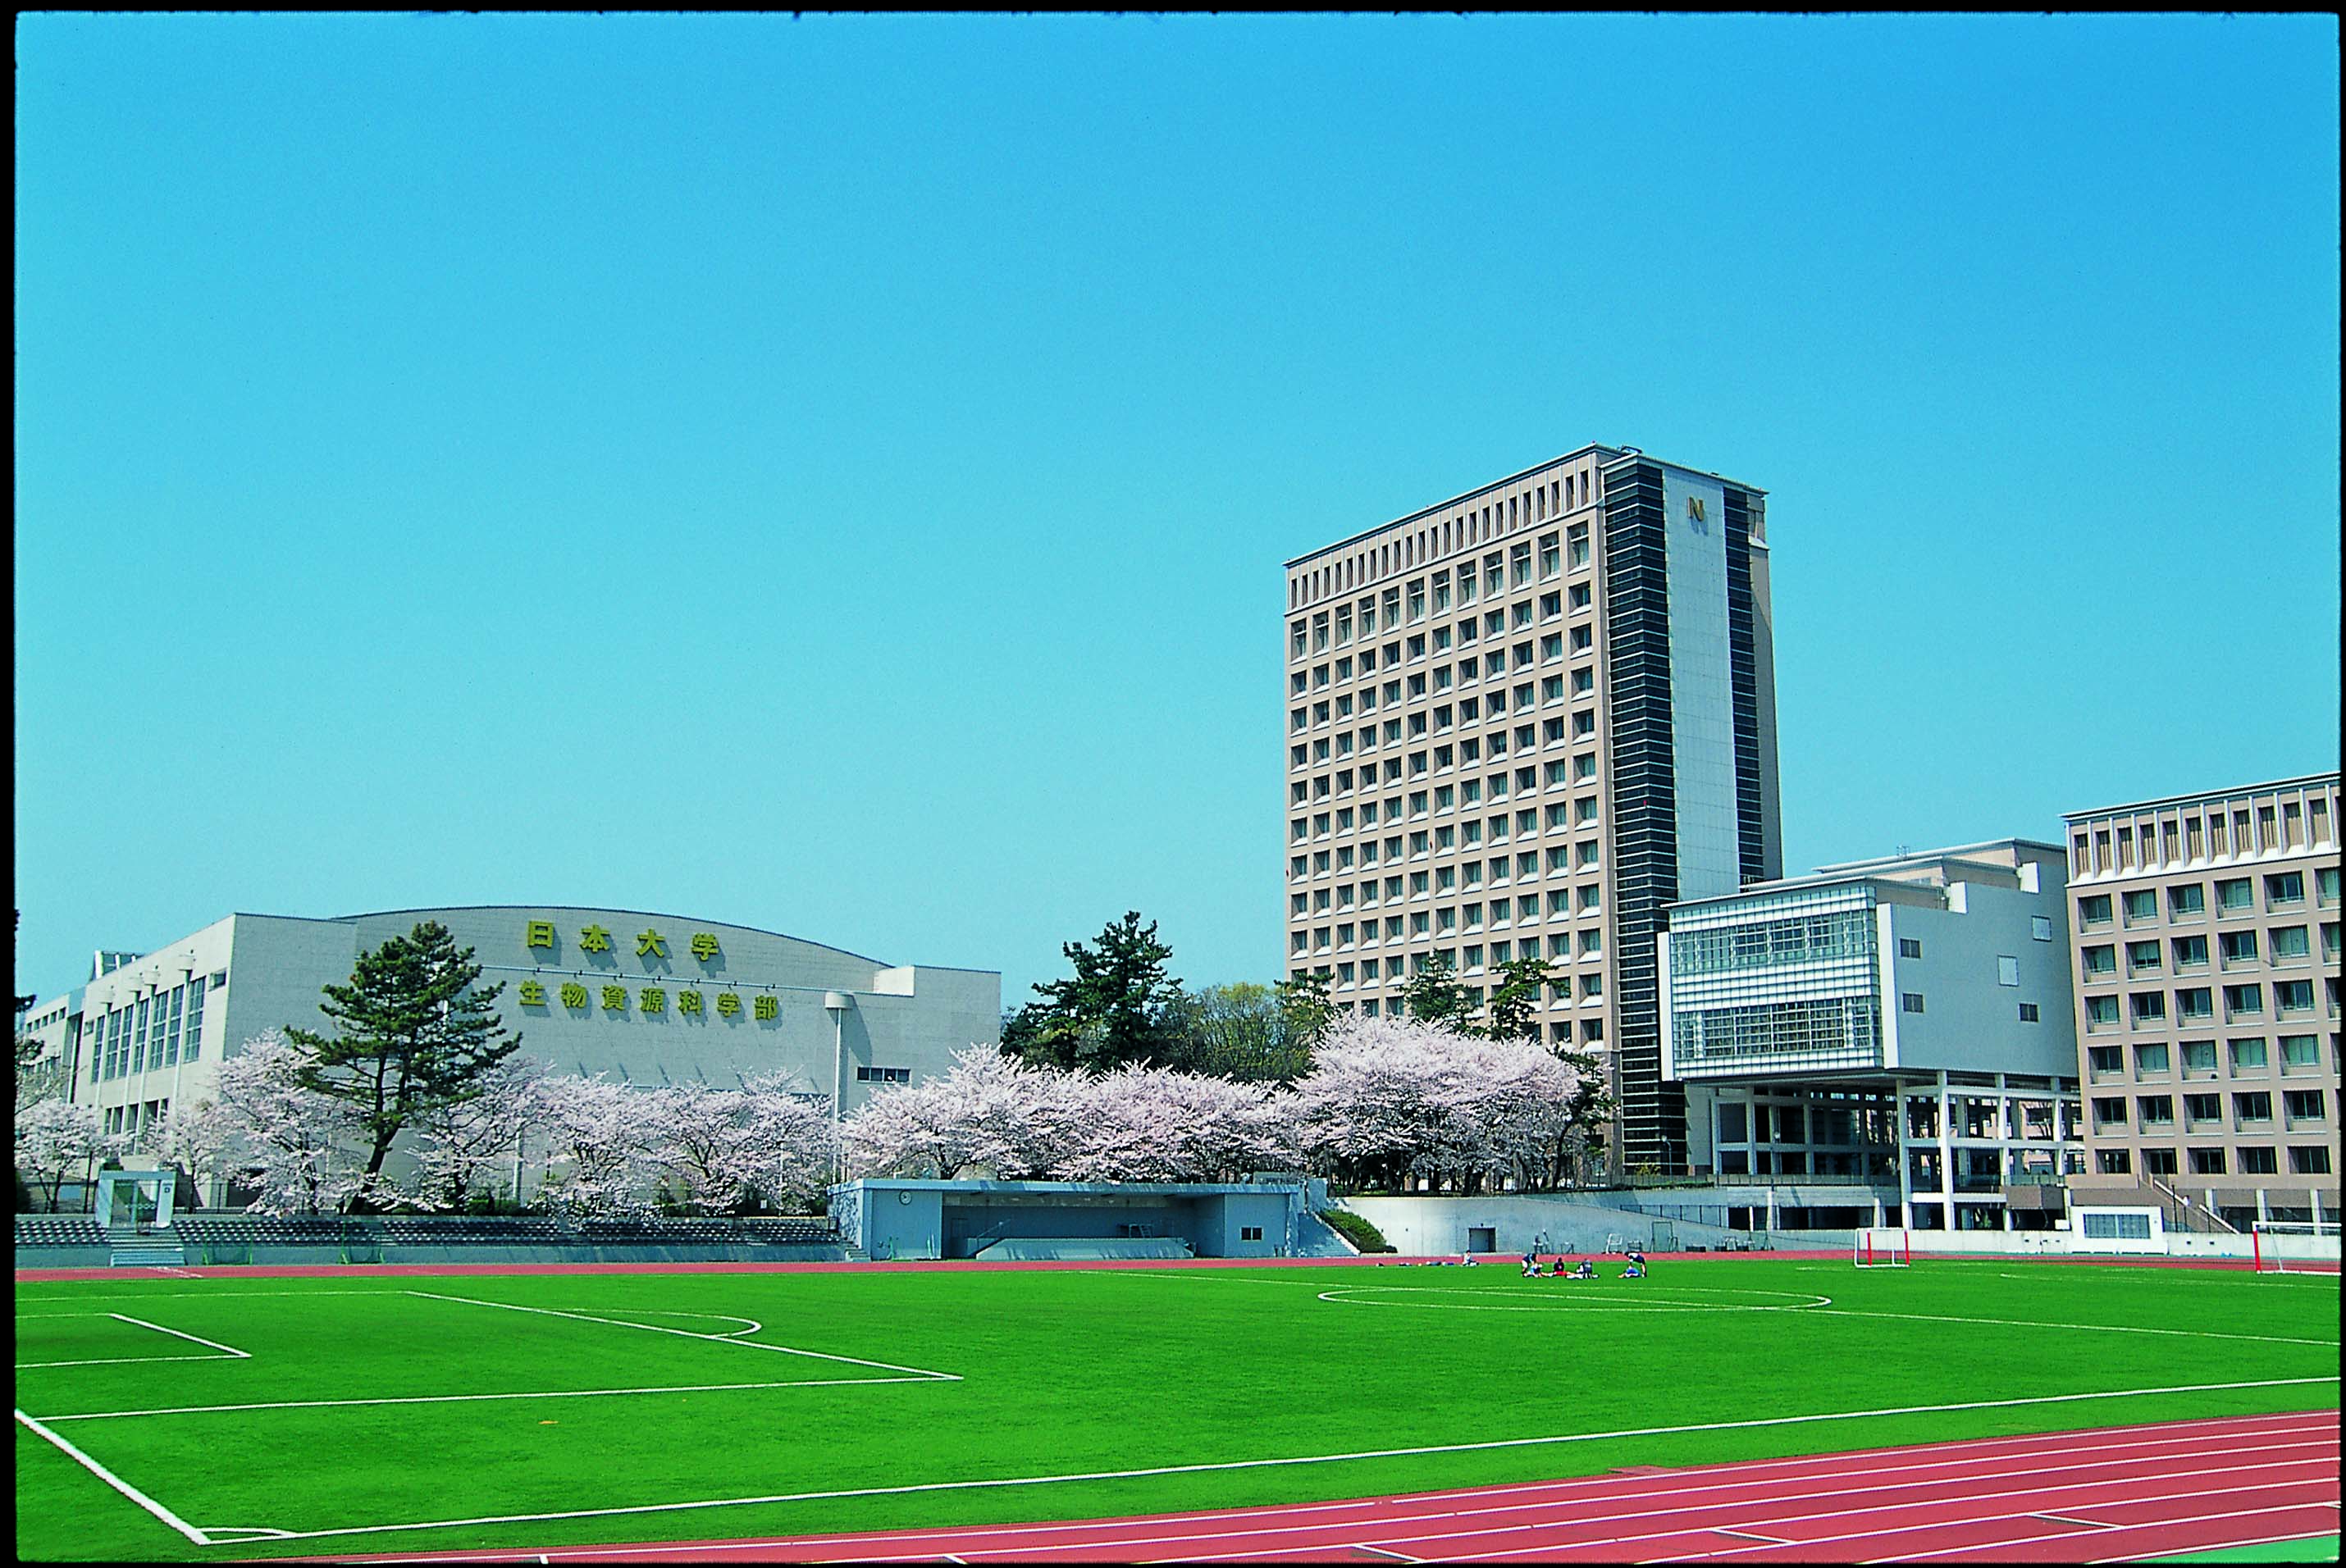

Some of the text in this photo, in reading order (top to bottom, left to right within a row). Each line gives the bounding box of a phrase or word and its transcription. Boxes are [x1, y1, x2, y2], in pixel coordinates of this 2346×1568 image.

[1687, 497, 1705, 522] N
[527, 920, 719, 961] 日本大学
[519, 980, 778, 1020] 生物資源科学部
